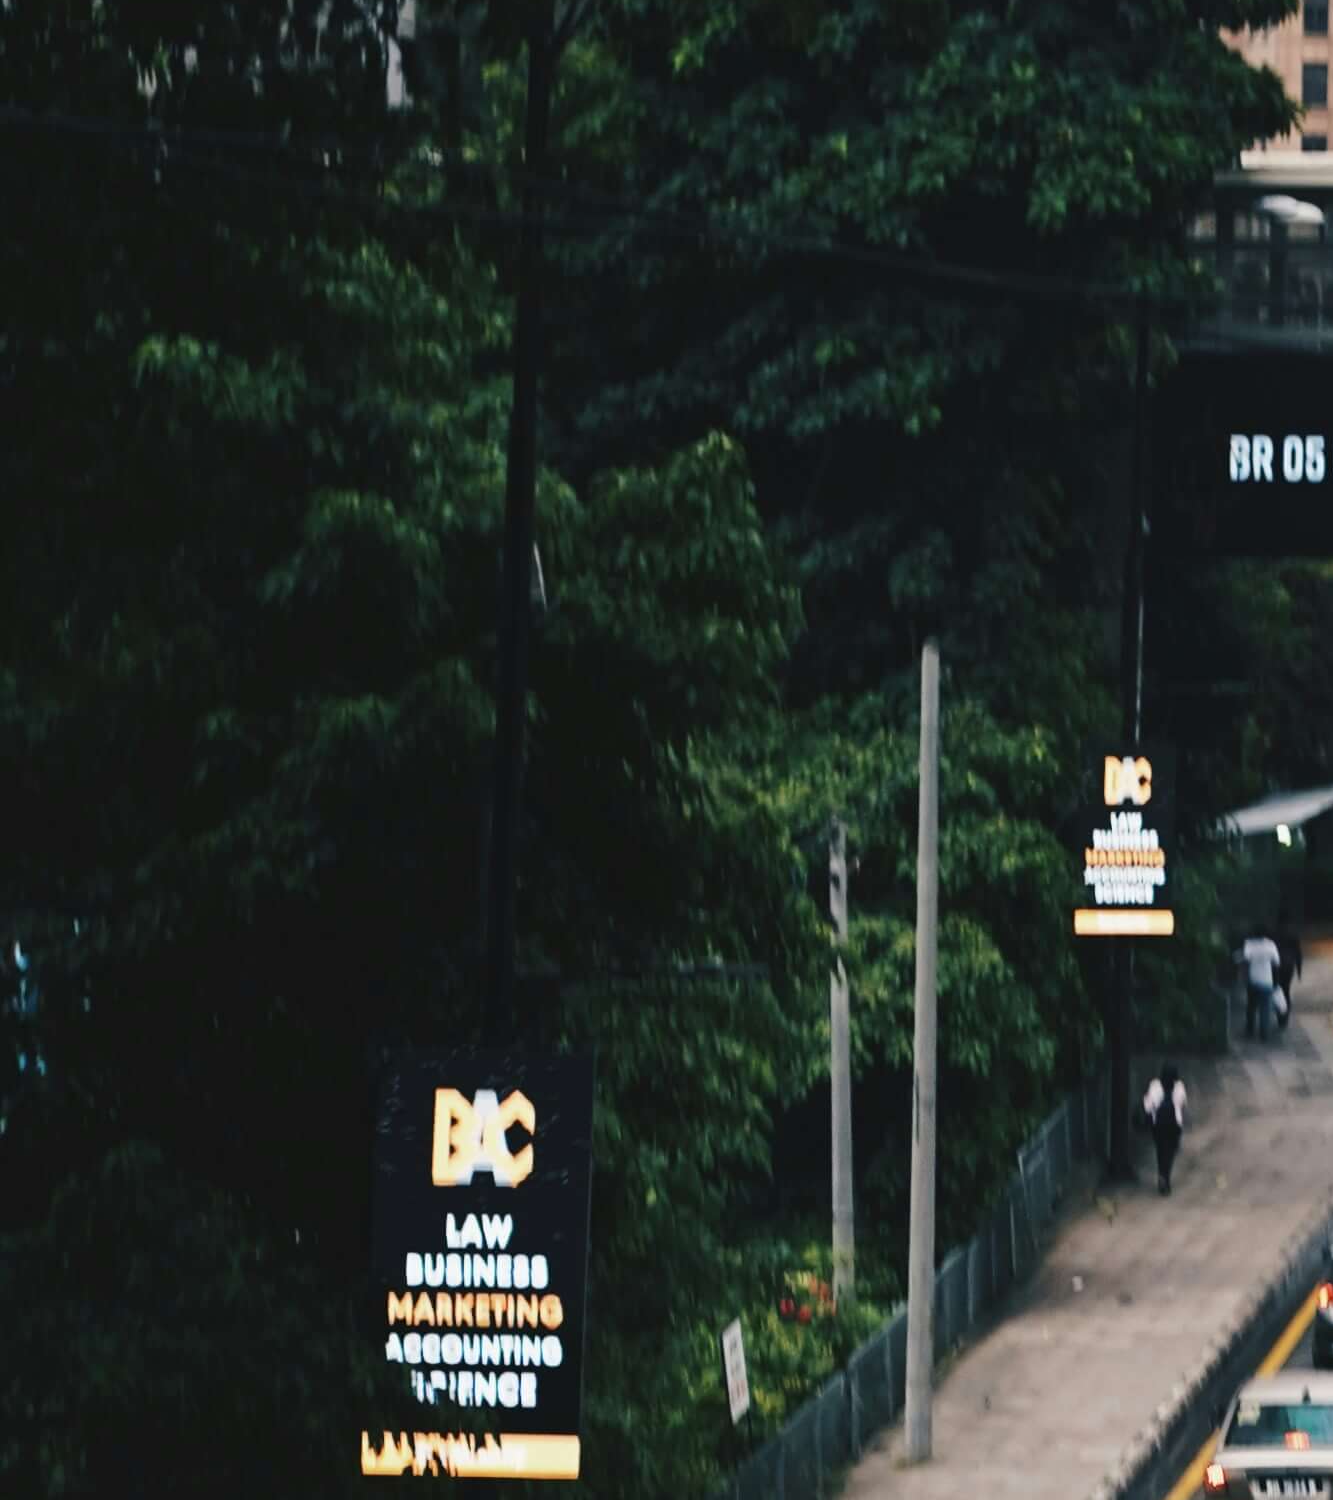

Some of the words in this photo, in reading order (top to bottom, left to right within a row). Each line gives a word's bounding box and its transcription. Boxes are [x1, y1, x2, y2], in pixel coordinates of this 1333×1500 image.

[1229, 434, 1274, 483] BR
[1282, 434, 1326, 483] 05
[445, 1213, 513, 1249] LAW
[406, 1252, 549, 1290] BUSINESS
[388, 1291, 563, 1330] MARKETING
[385, 1332, 563, 1367] ACCOUNTING
